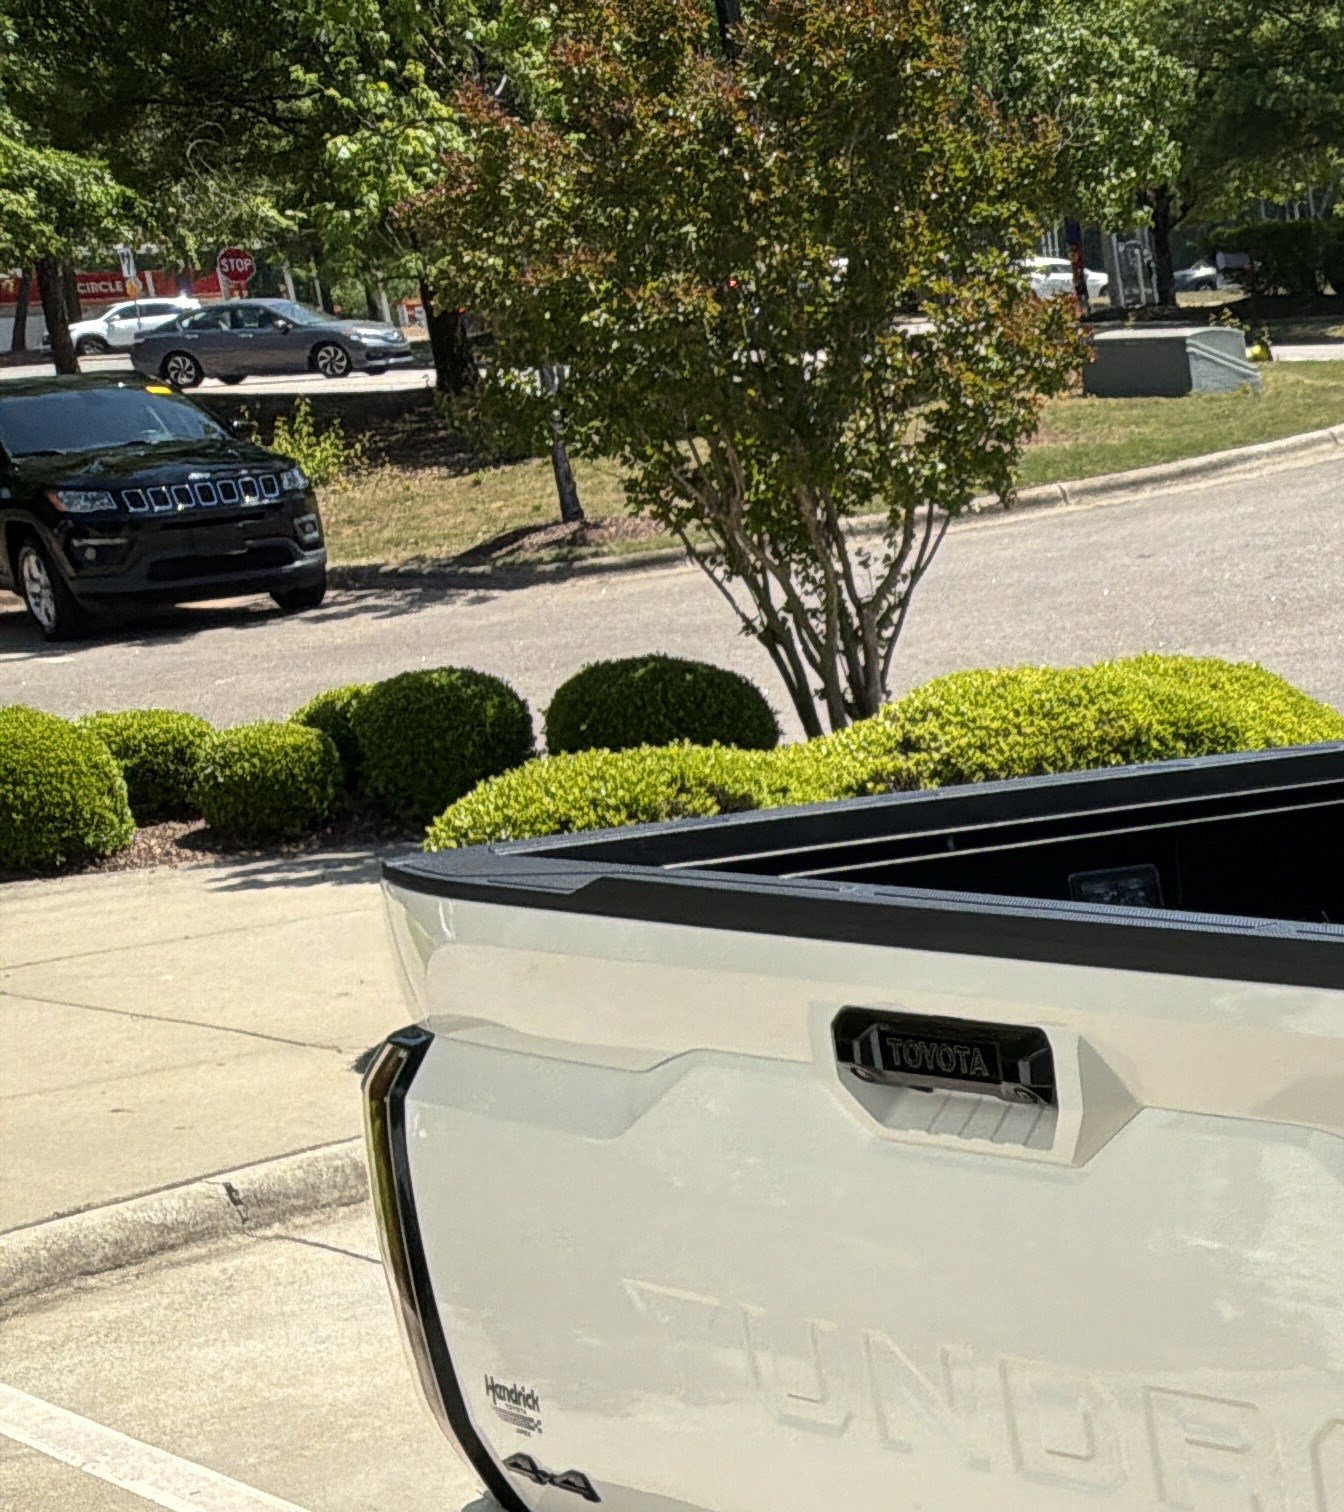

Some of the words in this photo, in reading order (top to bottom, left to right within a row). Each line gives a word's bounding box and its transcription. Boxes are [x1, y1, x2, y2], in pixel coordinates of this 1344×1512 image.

[220, 257, 252, 272] STOP
[77, 280, 124, 294] CIRCLE
[885, 1036, 991, 1078] TOYOTA
[484, 1373, 541, 1413] Hendrick
